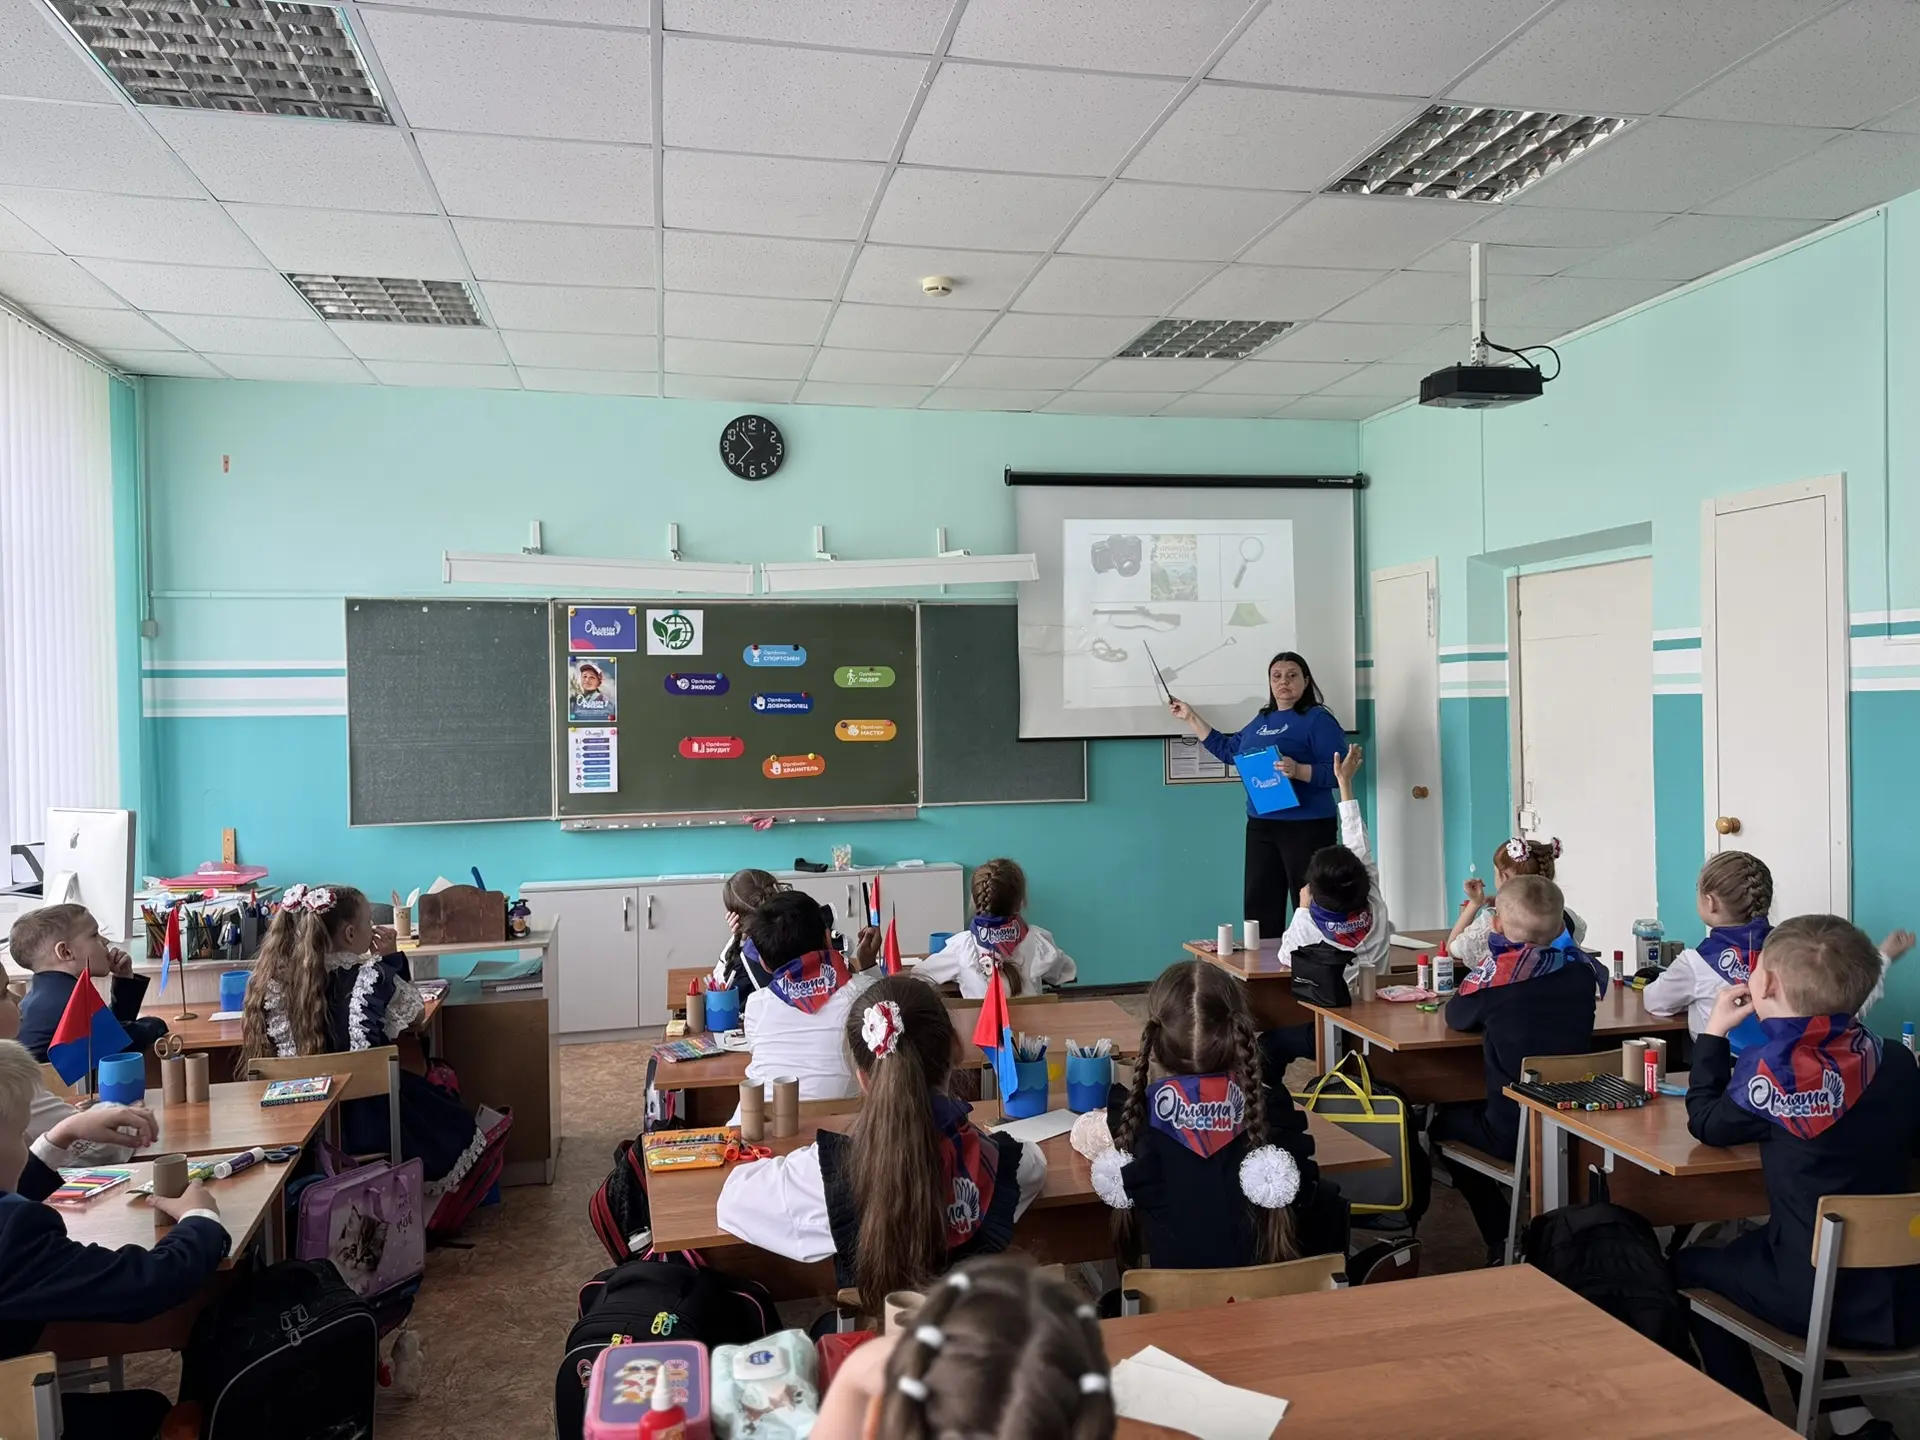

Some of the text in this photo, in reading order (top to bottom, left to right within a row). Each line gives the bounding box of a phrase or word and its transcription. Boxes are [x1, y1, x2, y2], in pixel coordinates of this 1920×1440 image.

[736, 421, 745, 432] 11
[747, 418, 757, 430] 12
[762, 423, 766, 433] 1
[727, 428, 736, 441] 10
[770, 431, 777, 443] 2
[722, 440, 730, 452] 9
[776, 443, 782, 455] 3
[728, 453, 735, 465] 8
[770, 456, 777, 466] 4
[749, 465, 756, 478] 6
[761, 462, 768, 475] 5
[1750, 1076, 1829, 1106] Орлята
[1156, 1087, 1231, 1121] Орлята
[1773, 1104, 1831, 1115] РОССИИ
[1176, 1117, 1232, 1129] РОССИИ
